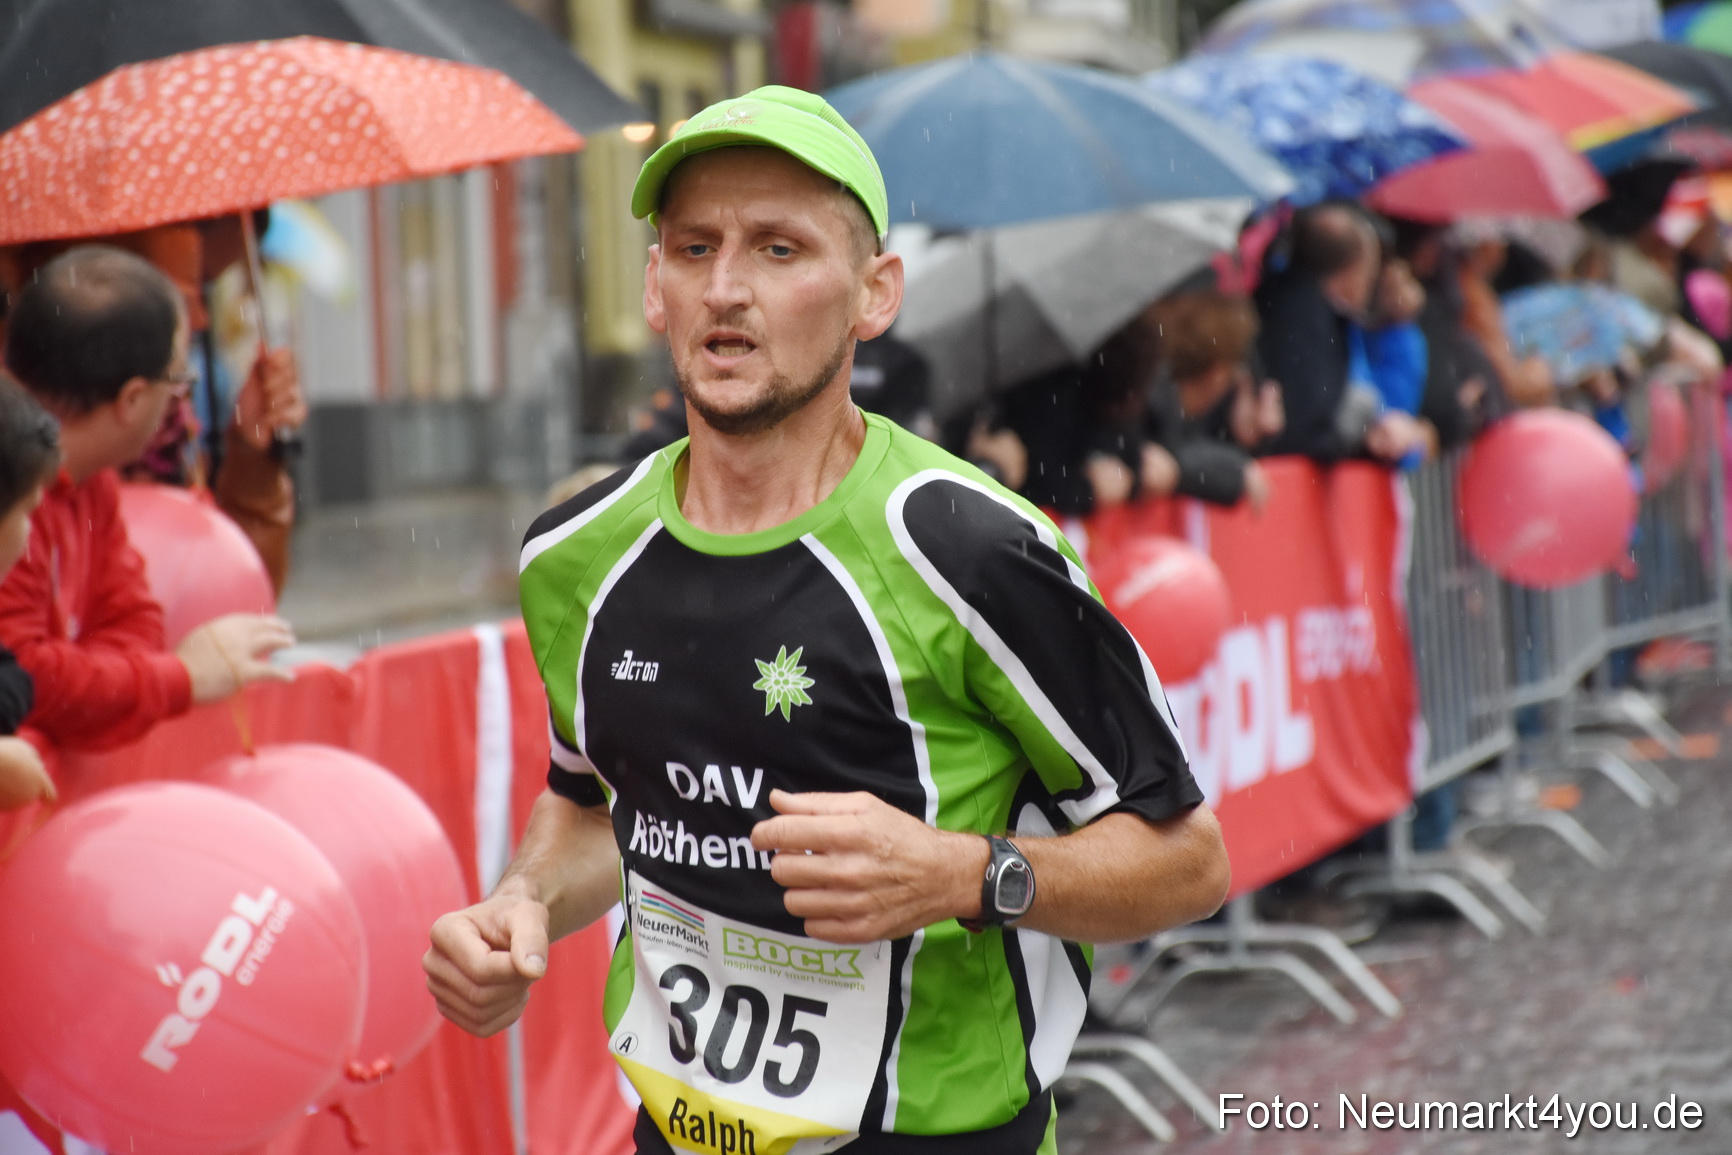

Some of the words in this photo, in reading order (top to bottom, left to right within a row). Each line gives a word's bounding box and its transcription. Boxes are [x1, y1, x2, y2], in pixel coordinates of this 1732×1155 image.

[665, 761, 764, 809] DAV
[629, 809, 774, 871] Röthen
[637, 911, 710, 953] NeuerMarkt
[722, 927, 864, 979] BOCK
[139, 884, 279, 1074] RÖDL
[723, 957, 766, 973] inspired
[769, 965, 782, 977] by
[785, 970, 815, 984] smart
[818, 976, 866, 992] concepts
[658, 963, 829, 1098] 305
[668, 1097, 756, 1155] Ralph
